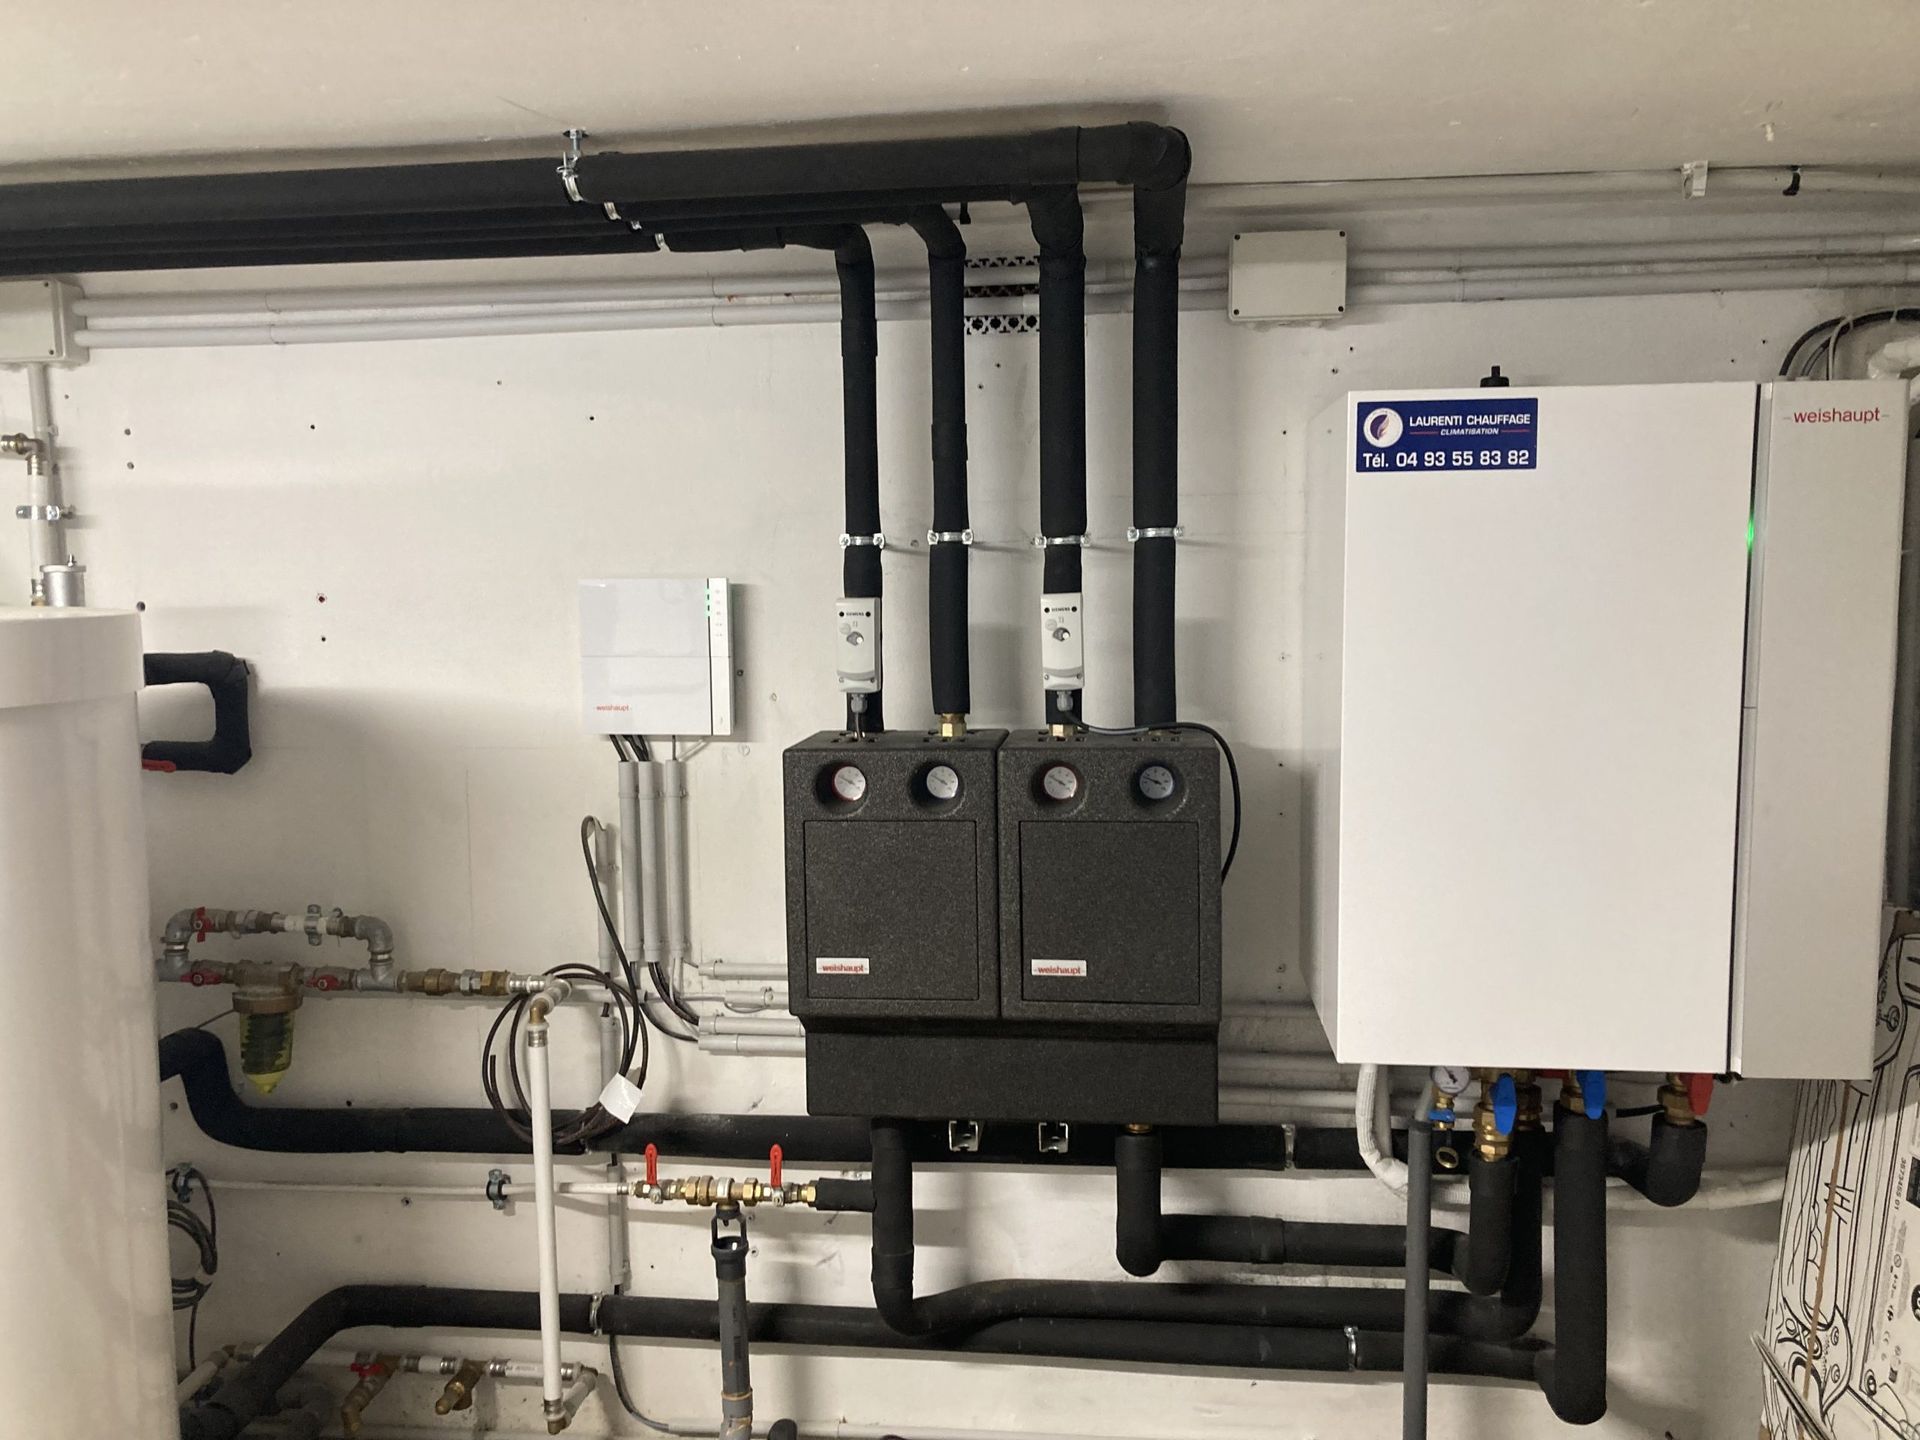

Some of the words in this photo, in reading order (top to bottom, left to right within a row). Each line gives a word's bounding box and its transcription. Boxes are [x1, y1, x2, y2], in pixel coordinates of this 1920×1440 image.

[1409, 416, 1462, 427] LAURENTI
[1466, 414, 1531, 425] CHAUFFAGE
[1793, 407, 1880, 424] weishaupt
[1440, 428, 1499, 436] CLIMATISATION
[1363, 453, 1389, 468] Tél.
[1396, 452, 1418, 467] 04
[1424, 451, 1446, 467] 93
[1452, 451, 1473, 466] 55
[1480, 450, 1501, 466] 83
[1507, 450, 1529, 465] 82
[596, 704, 630, 712] weishaupt
[822, 964, 864, 973] weishaupt
[1037, 965, 1081, 975] weishaupt
